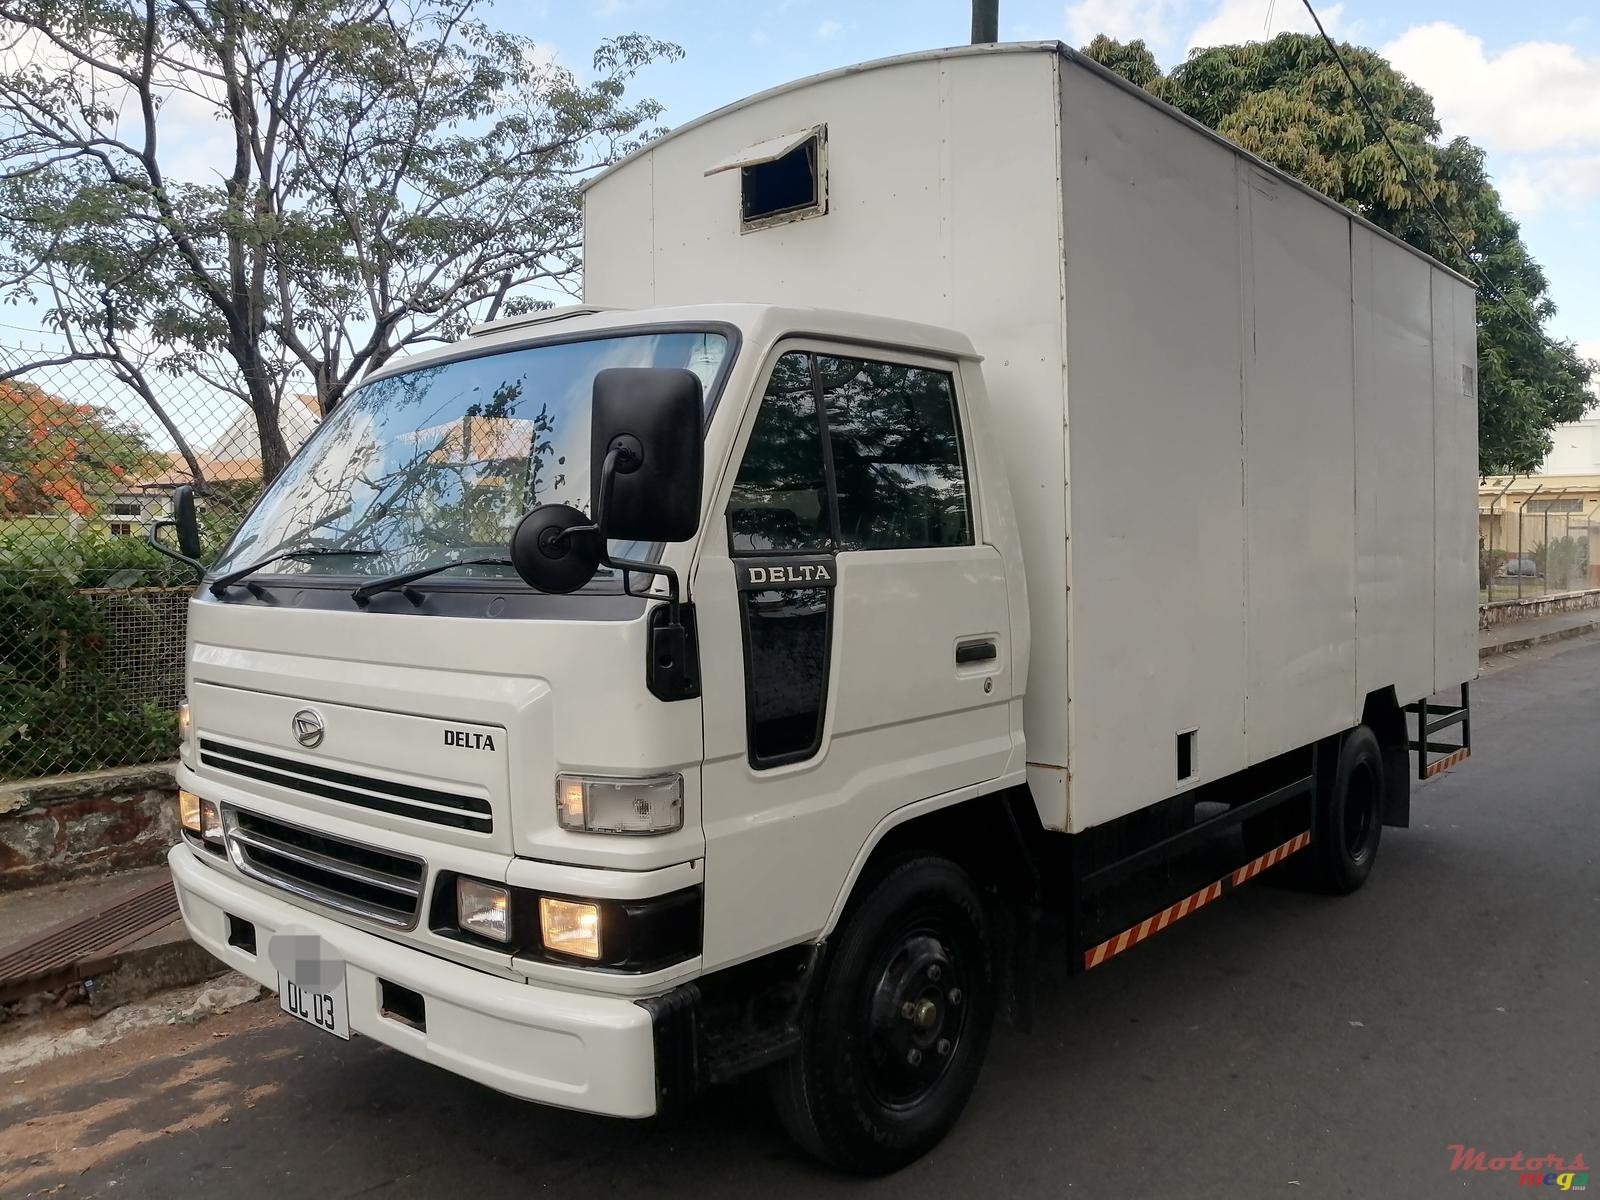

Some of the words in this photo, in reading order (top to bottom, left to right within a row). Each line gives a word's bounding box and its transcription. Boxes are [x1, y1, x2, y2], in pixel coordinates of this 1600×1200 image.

[748, 565, 831, 584] DELTA
[444, 729, 496, 752] DELTA
[313, 993, 335, 1031] 03
